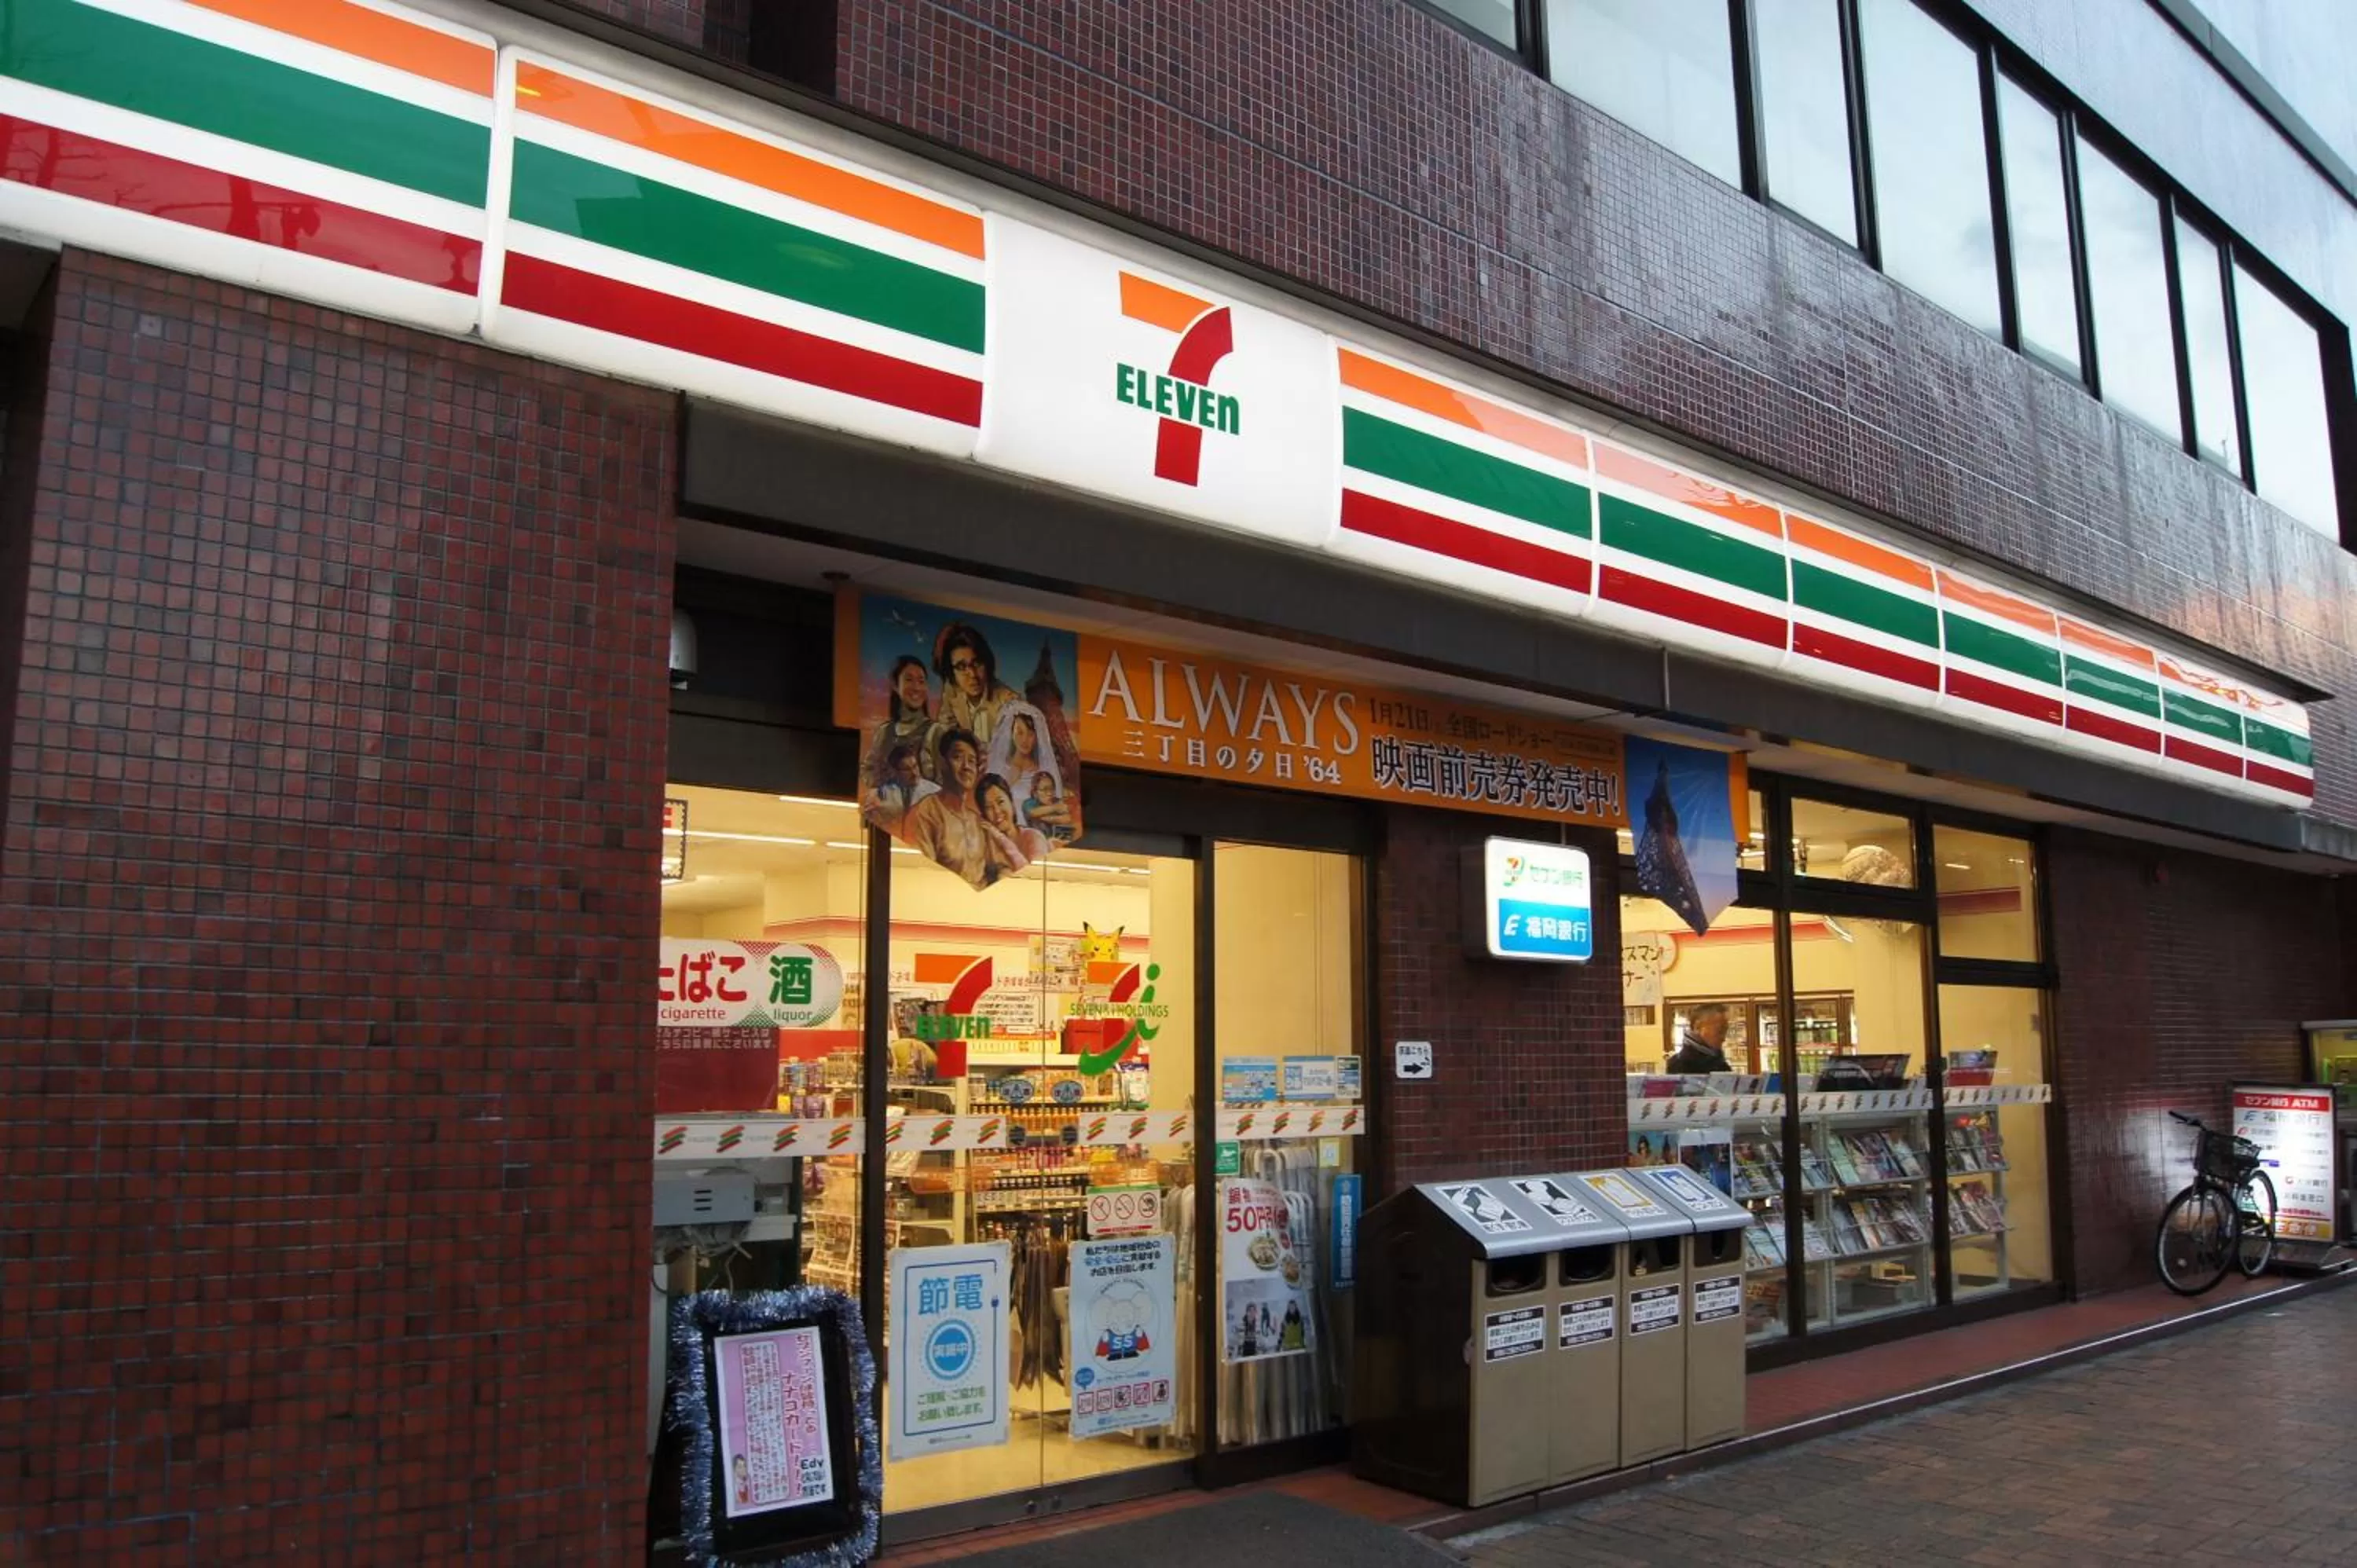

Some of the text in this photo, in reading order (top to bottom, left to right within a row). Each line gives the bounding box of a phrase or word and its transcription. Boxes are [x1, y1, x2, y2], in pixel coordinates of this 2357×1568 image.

[1087, 650, 1358, 755] ALWAYS
[769, 955, 813, 1005] 酒
[661, 1007, 813, 1022] cigarette liquor
[2291, 1098, 2319, 1108] ATM
[918, 1273, 984, 1316] 節電
